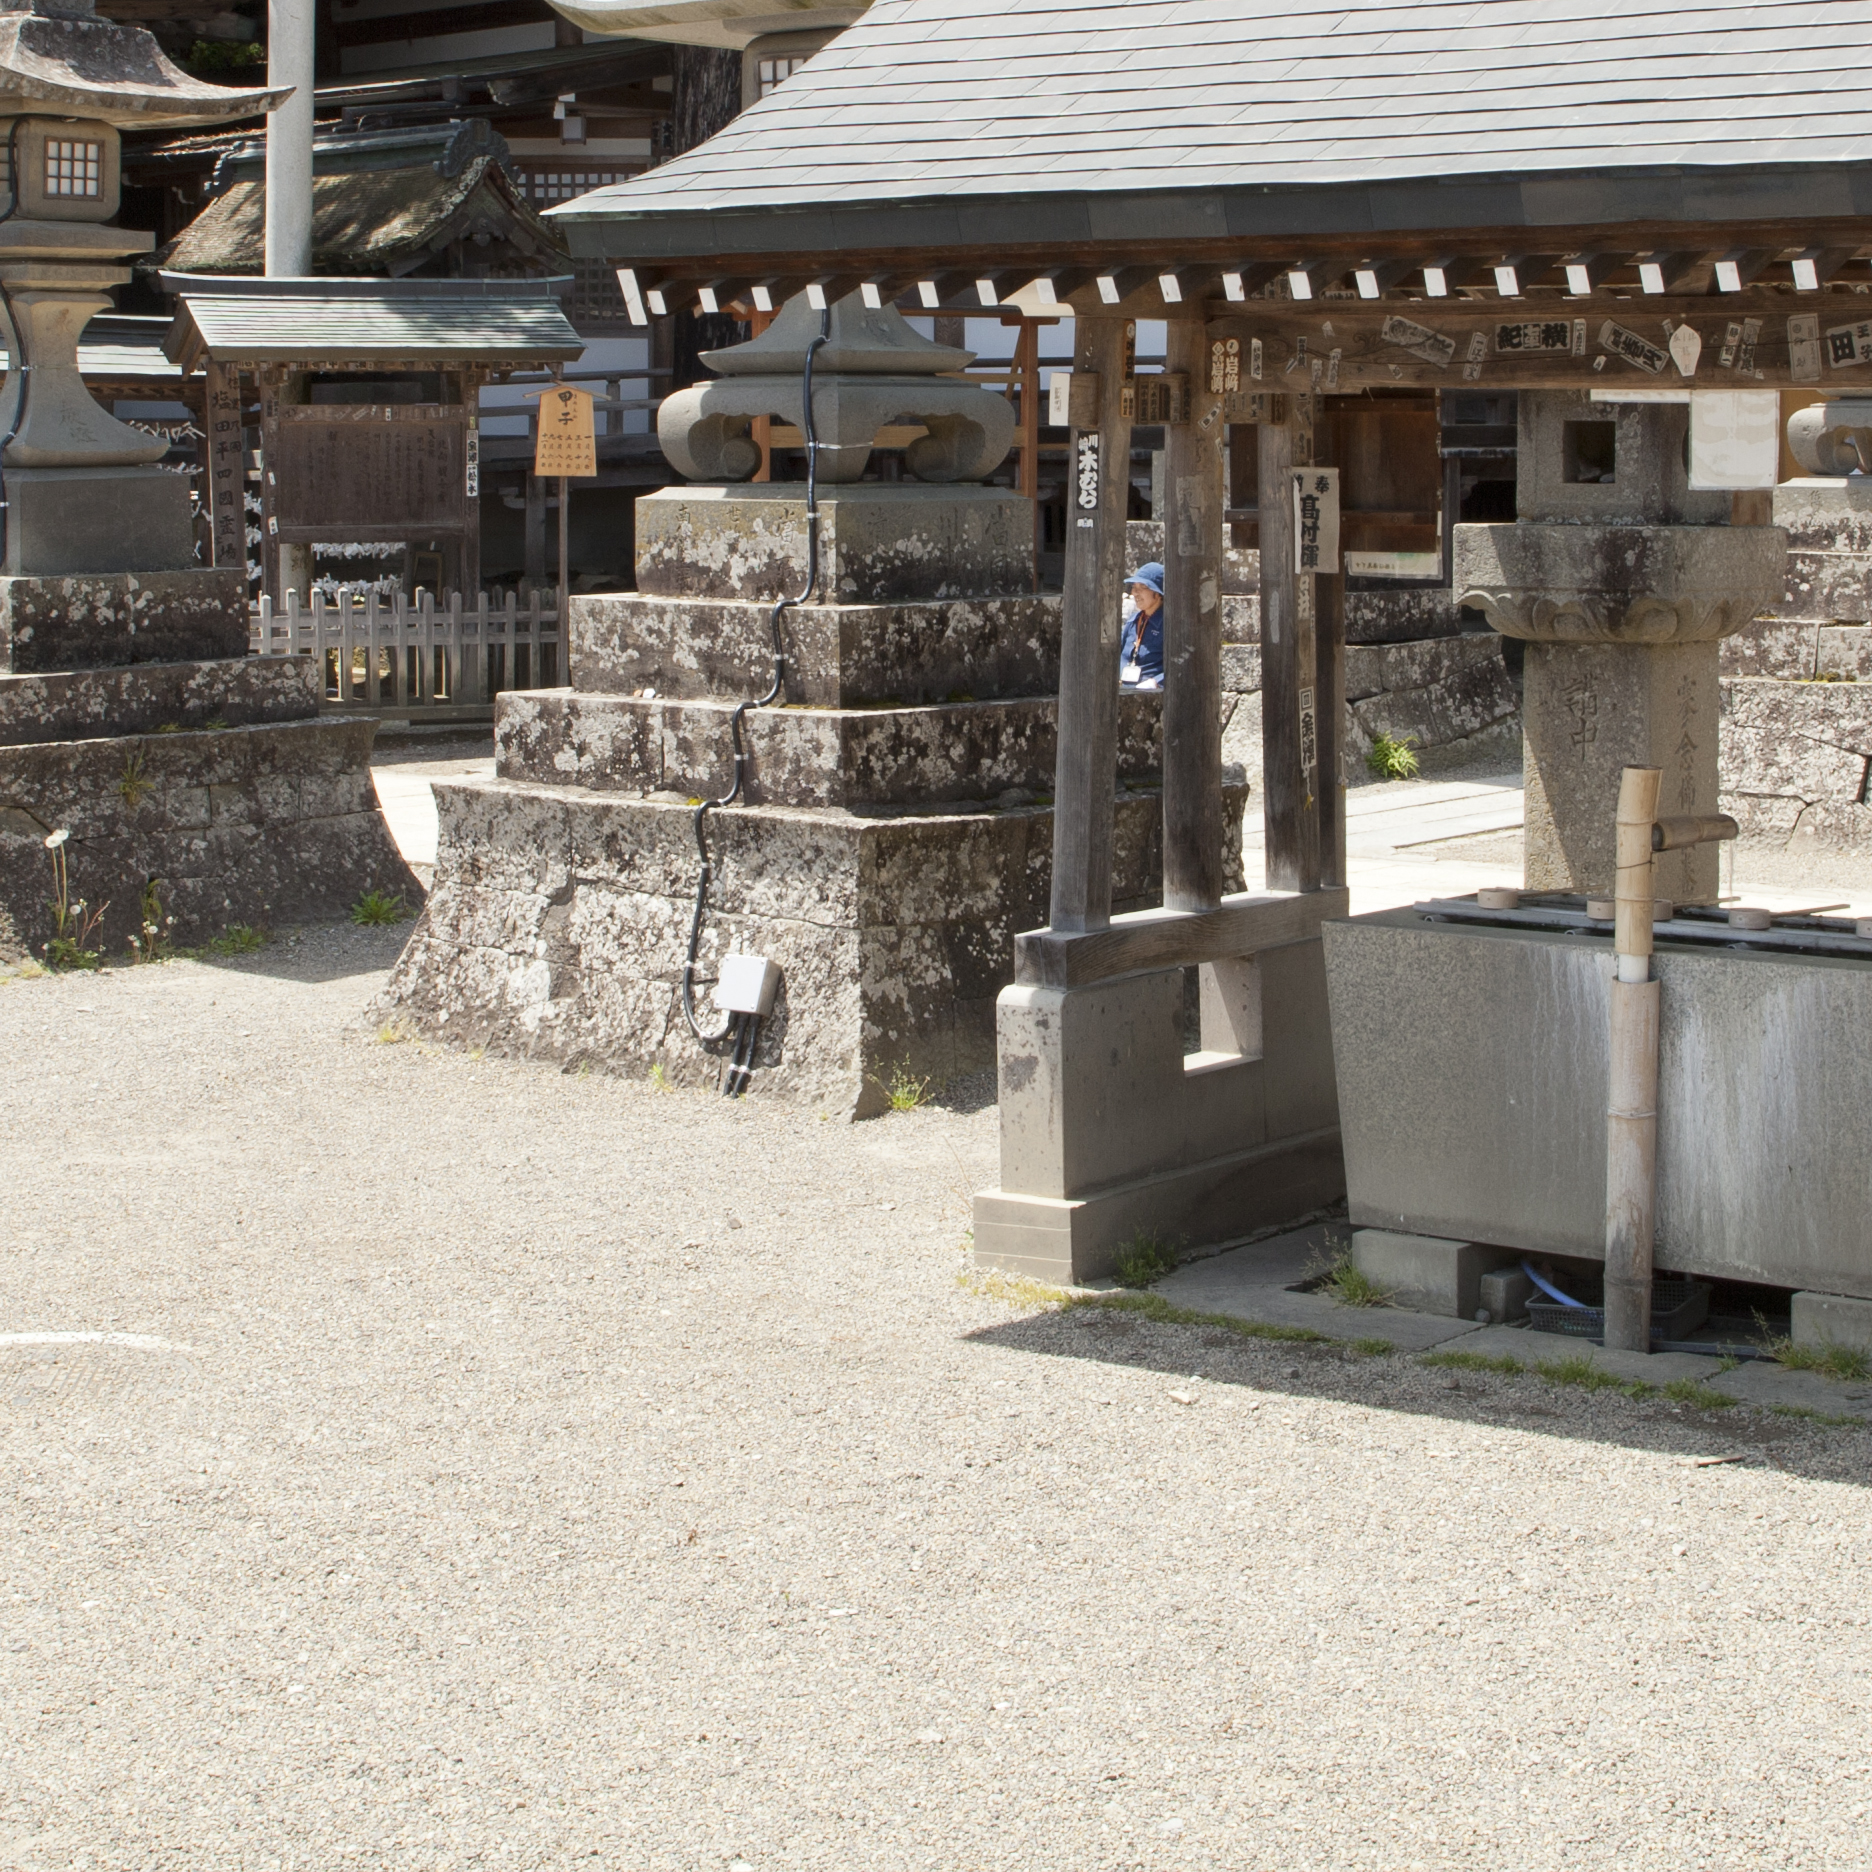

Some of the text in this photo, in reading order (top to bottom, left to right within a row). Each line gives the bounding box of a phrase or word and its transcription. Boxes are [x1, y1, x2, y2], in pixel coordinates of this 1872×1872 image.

[557, 389, 574, 426] 甲子
[1079, 451, 1100, 509] 木むら
